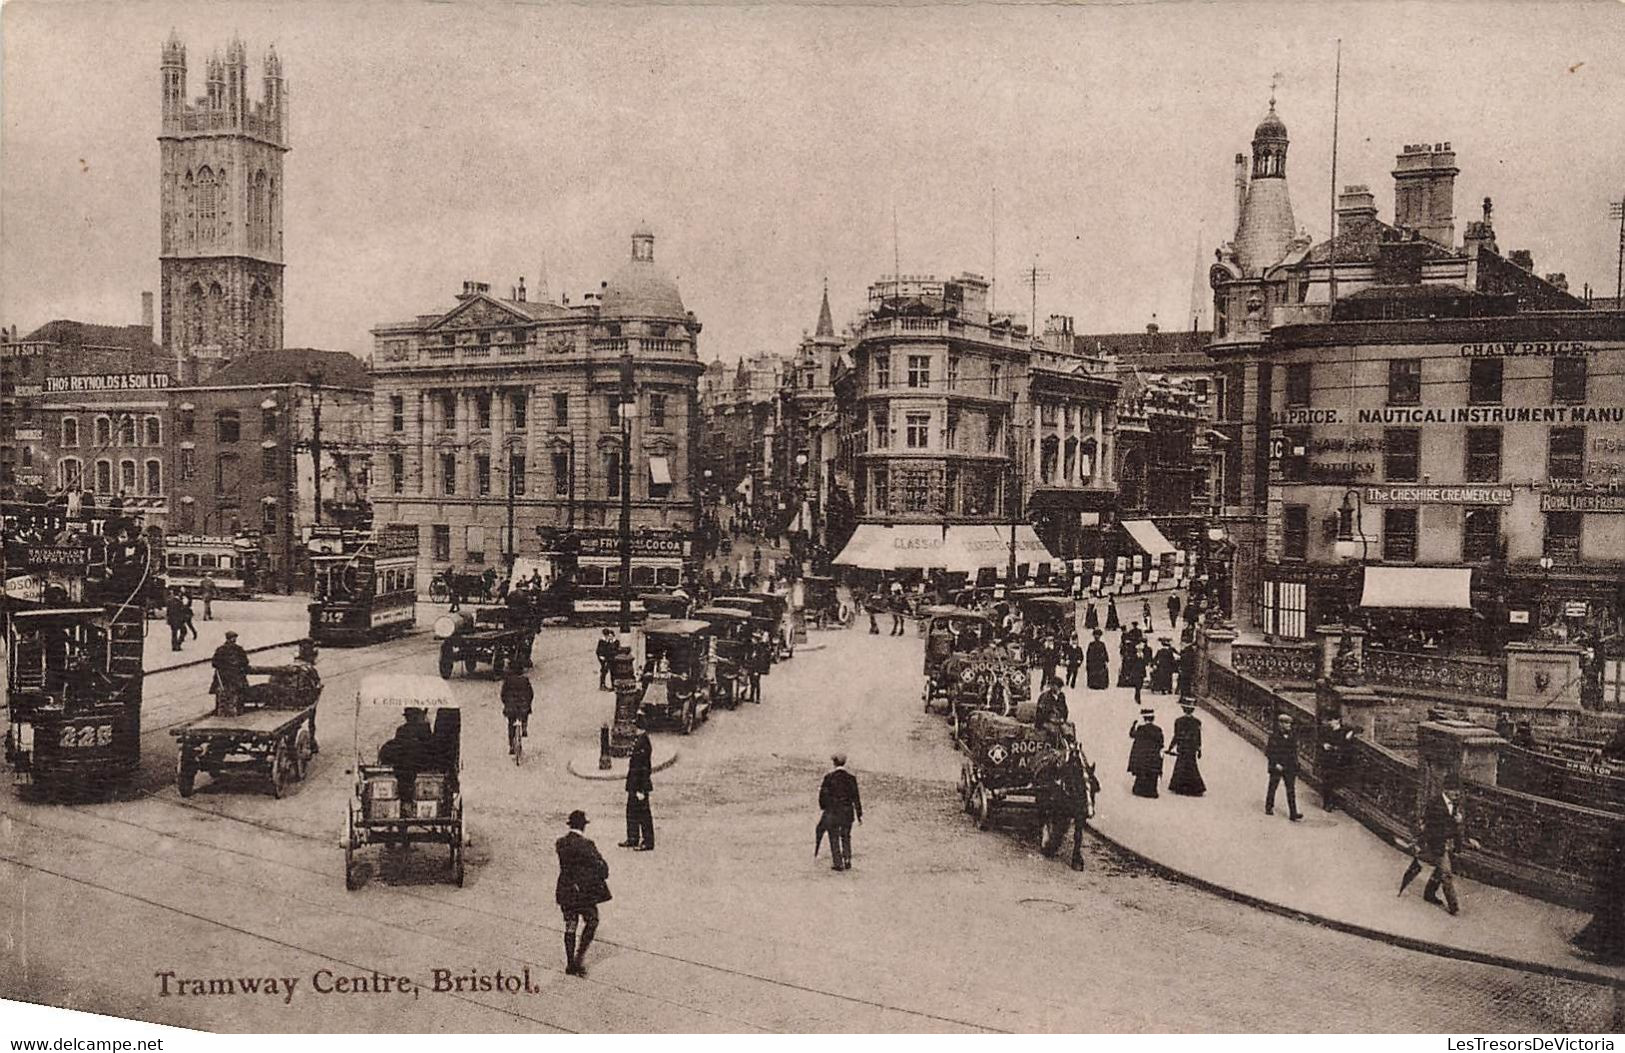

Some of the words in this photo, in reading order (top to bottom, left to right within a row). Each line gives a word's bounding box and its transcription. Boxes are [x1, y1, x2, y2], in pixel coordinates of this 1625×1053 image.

[71, 376, 120, 389] REYNOLDS
[121, 377, 128, 388] &
[129, 375, 149, 387] SON
[151, 374, 168, 387] LTD
[1358, 409, 1446, 423] NAUTICAL
[1451, 408, 1567, 422] INSTRUMENT
[1571, 407, 1624, 421] MANU
[1367, 490, 1388, 500] The
[1390, 489, 1439, 501] CHESHIRE
[1441, 489, 1489, 501] CREAMERY
[646, 539, 680, 550] COCOA
